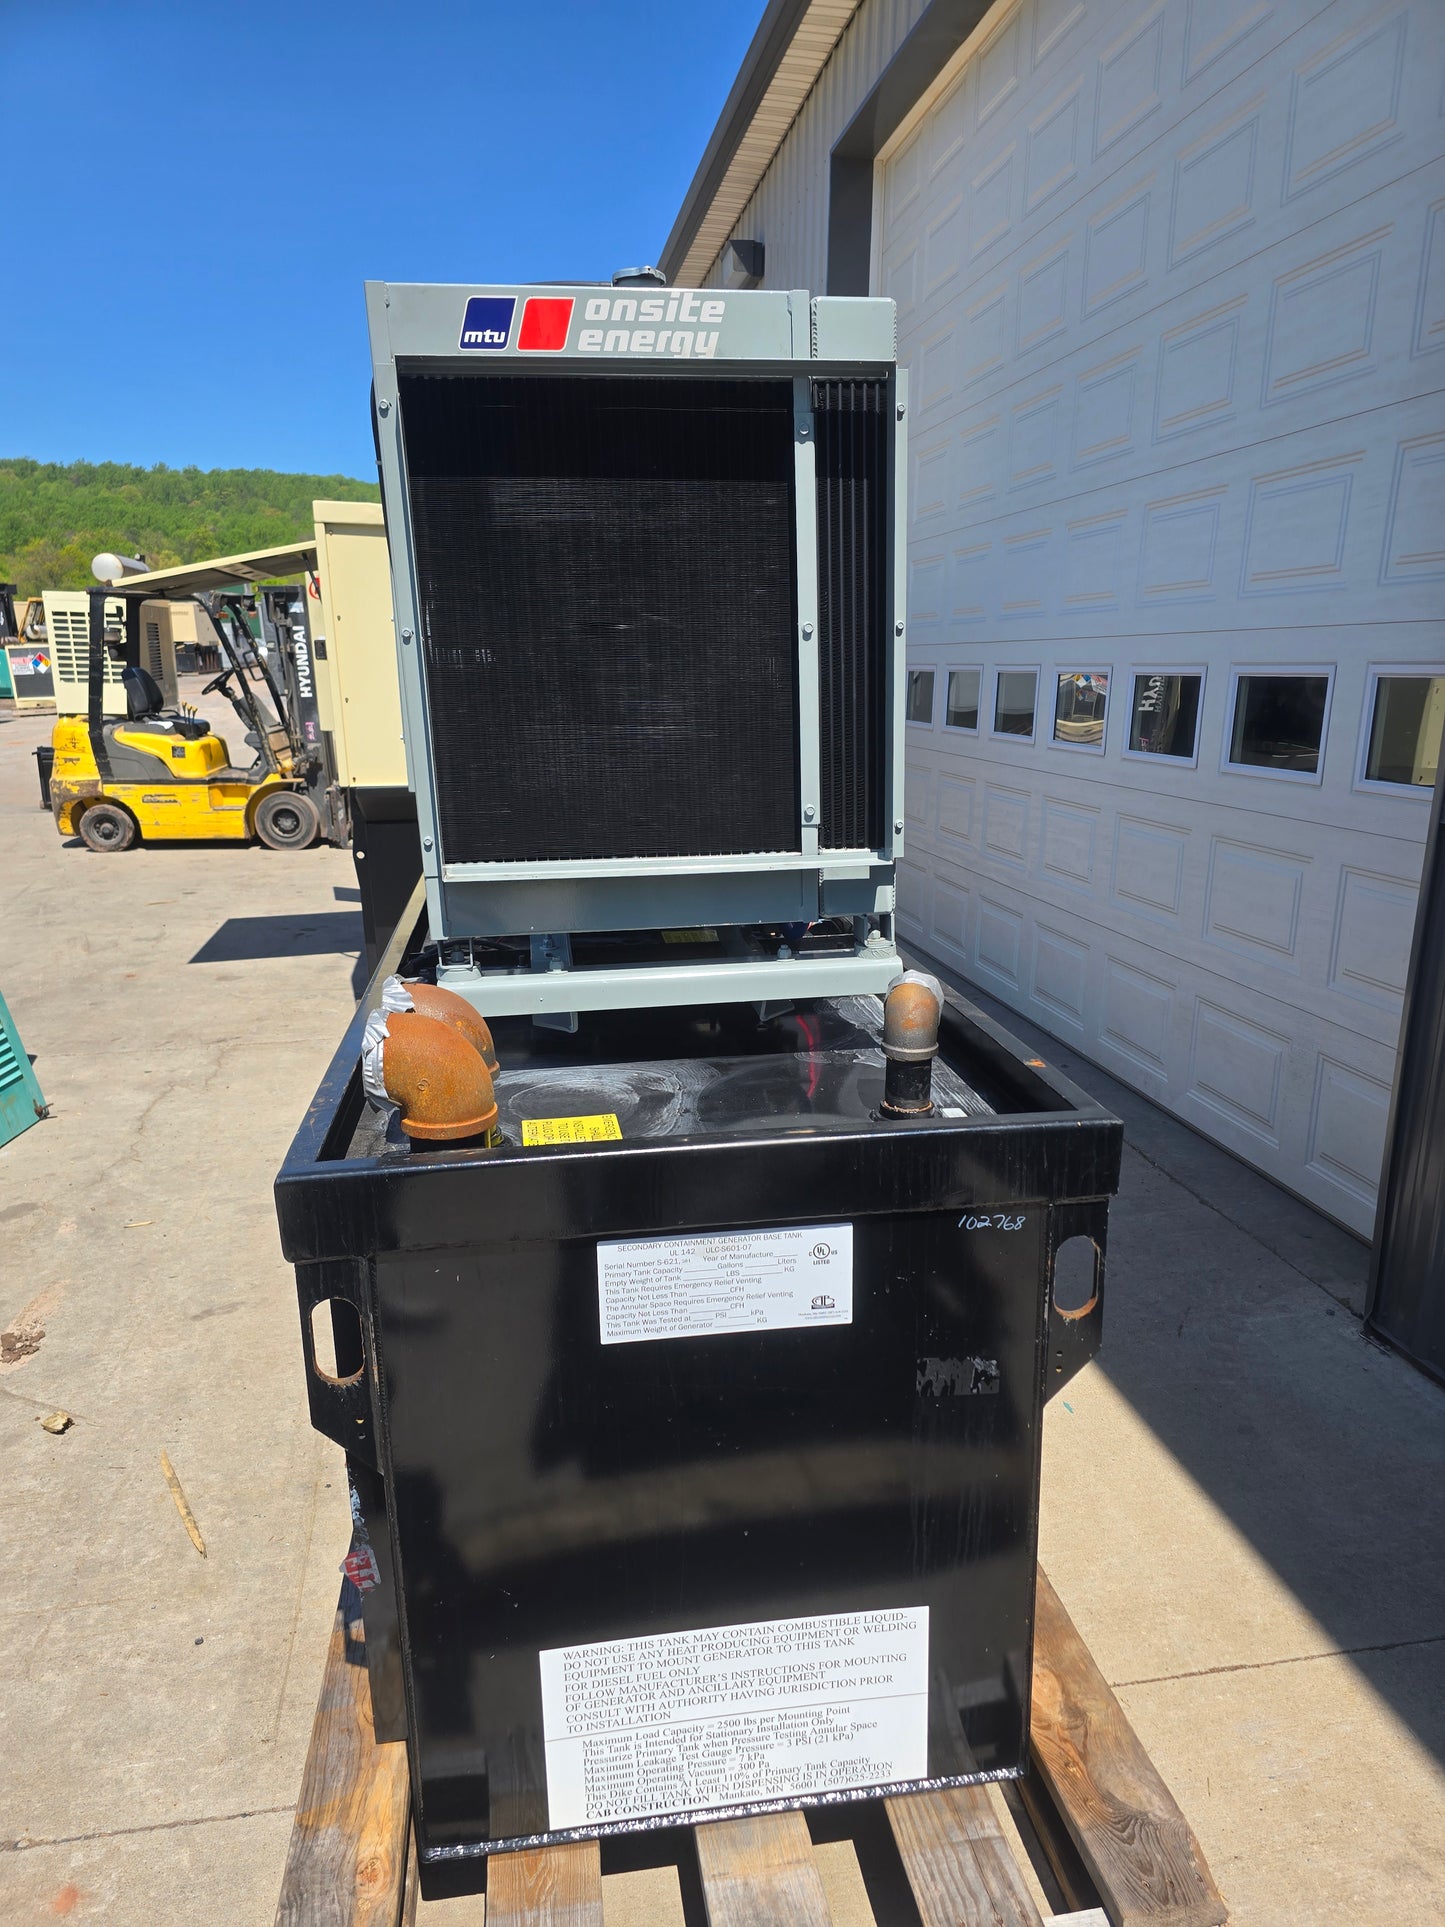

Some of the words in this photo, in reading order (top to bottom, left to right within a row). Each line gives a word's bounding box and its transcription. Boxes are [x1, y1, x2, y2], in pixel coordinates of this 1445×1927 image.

[585, 292, 726, 323] onsite
[464, 329, 505, 343] mtu
[578, 329, 720, 358] energy
[292, 626, 313, 698] HYUNDAI
[602, 1116, 617, 1139] EMERGENC
[958, 1215, 1026, 1231] 102768
[618, 1243, 661, 1252] SECONDARY
[664, 1238, 715, 1248] CONTAINMENT
[718, 1235, 761, 1244] GENERATOR
[706, 1244, 752, 1254] ULC-S601-07
[817, 1246, 826, 1255] UL
[605, 1271, 631, 1279] Primary
[653, 1268, 683, 1276] Capacity
[627, 1261, 655, 1269] Number
[729, 1252, 774, 1260] Manufacture
[605, 1280, 627, 1289] Empty
[641, 1285, 672, 1293] Requires
[674, 1281, 713, 1290] Emergency
[714, 1278, 734, 1286] Relief
[736, 1277, 762, 1285] Venting
[606, 1296, 636, 1304] Capacity
[621, 1303, 648, 1311] Annular
[650, 1301, 672, 1309] Space
[674, 1298, 704, 1307] Requires
[706, 1294, 744, 1304] Emergency
[746, 1292, 766, 1300] Relief
[768, 1291, 794, 1299] Venting
[606, 1330, 642, 1338] Maximum
[643, 1326, 668, 1335] Weight
[678, 1322, 713, 1331] Generator
[564, 1645, 624, 1660] WARNING:
[627, 1641, 654, 1651] THIS
[657, 1636, 690, 1648] TANK
[693, 1632, 719, 1643] MAY
[722, 1625, 775, 1640] CONTAIN
[778, 1617, 860, 1633] COMBUSTIBLE
[864, 1613, 908, 1624] LIQUID-
[564, 1662, 581, 1672] DO
[584, 1657, 610, 1668] NOT
[612, 1653, 636, 1664] USE
[639, 1650, 664, 1660] ANY
[668, 1645, 698, 1657] HEAT
[701, 1637, 770, 1652] PRODUCING
[773, 1629, 841, 1644] EQUIPMENT
[844, 1627, 860, 1636] OR
[863, 1621, 917, 1634] WELDING
[564, 1664, 635, 1682] EQUIPMENT
[637, 1662, 654, 1671] TO
[657, 1655, 700, 1668] MOUNT
[703, 1647, 774, 1662] GENERATOR
[776, 1644, 792, 1653] TO
[795, 1641, 821, 1651] THIS
[824, 1637, 855, 1648] TANK
[565, 1688, 616, 1704] FOLLOW
[731, 1663, 816, 1681] INSTRUCTIONS
[819, 1660, 841, 1670] FOR
[844, 1653, 907, 1667] MOUNTING
[565, 1682, 588, 1693] FOR
[592, 1676, 634, 1689] DIESEL
[636, 1671, 666, 1682] FUEL
[669, 1666, 700, 1677] ONLY
[565, 1703, 581, 1713] OF
[584, 1692, 656, 1709] GENERATOR
[660, 1688, 685, 1699] AND
[688, 1679, 755, 1695] ANCILLARY
[759, 1671, 826, 1686] EQUIPMENT
[567, 1708, 621, 1724] CONSULT
[625, 1703, 655, 1714] WITH
[659, 1693, 728, 1710] AUTHORITY
[730, 1688, 775, 1701] HAVING
[778, 1678, 856, 1695] JURISDICTION
[860, 1675, 893, 1686] PRIOR
[567, 1724, 582, 1734] TO
[586, 1711, 671, 1731] INSTALLATION
[582, 1735, 633, 1749] Maximum
[636, 1730, 660, 1741] Load
[663, 1724, 705, 1737] Capacity
[718, 1719, 740, 1730] 2500
[744, 1718, 757, 1726] lbs
[760, 1717, 775, 1726] per
[778, 1710, 823, 1722] Mounting
[826, 1706, 850, 1716] Point
[583, 1749, 604, 1758] This
[607, 1744, 631, 1754] Tank
[634, 1740, 642, 1750] is
[645, 1735, 686, 1749] Intended
[689, 1733, 703, 1743] for
[706, 1728, 754, 1740] Stationary
[757, 1720, 808, 1733] Installation
[811, 1717, 835, 1726] Only
[583, 1754, 633, 1767] Pressurize
[636, 1748, 674, 1759] Primary
[677, 1743, 700, 1753] Tank
[703, 1739, 728, 1749] when
[731, 1735, 771, 1746] Pressure
[773, 1730, 807, 1740] Testing
[810, 1724, 848, 1736] Annular
[850, 1721, 878, 1732] Space
[584, 1771, 634, 1785] Maximum
[637, 1763, 684, 1777] Operating
[688, 1759, 727, 1770] Pressure
[748, 1752, 765, 1761] kPa
[586, 1802, 603, 1811] DO
[606, 1798, 631, 1808] NOT
[634, 1794, 658, 1804] FILL
[660, 1789, 691, 1800] TANK
[696, 1784, 730, 1795] WHEN
[733, 1774, 800, 1789] DISPENSING
[803, 1772, 813, 1780] IS
[816, 1770, 827, 1779] IN
[830, 1762, 893, 1777] OPERATION
[586, 1809, 612, 1820] CAB
[615, 1796, 710, 1815] CONSTRUCTION
[720, 1789, 762, 1801] Mankato,
[766, 1785, 784, 1794] MN
[790, 1781, 816, 1791] 56001
[824, 1769, 891, 1787] (507)625-2233
